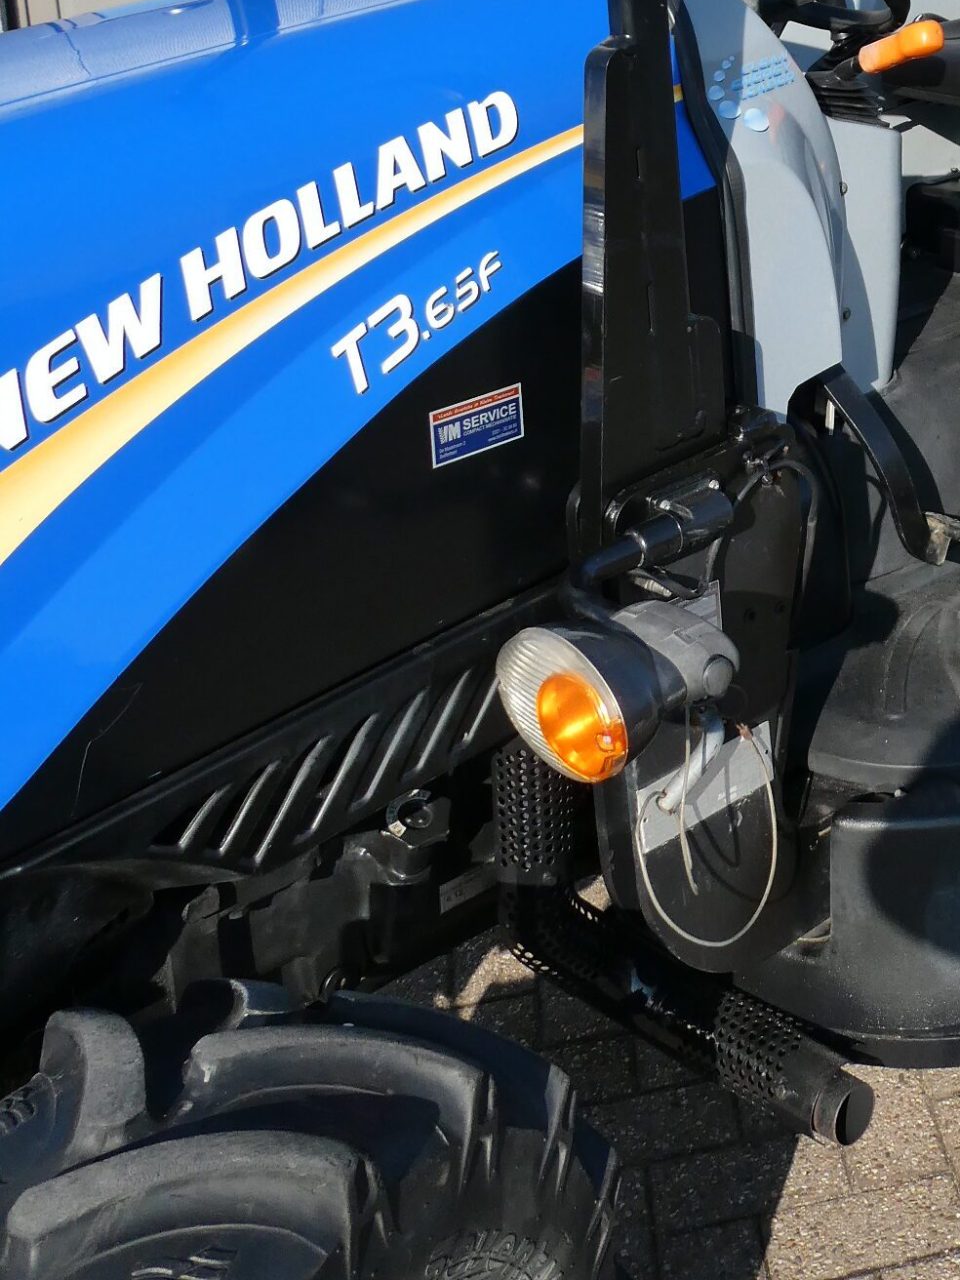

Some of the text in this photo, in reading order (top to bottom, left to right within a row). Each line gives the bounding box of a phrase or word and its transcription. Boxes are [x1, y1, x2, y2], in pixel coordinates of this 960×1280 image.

[180, 91, 518, 321] HOLLAND
[331, 250, 502, 396] T3.65F
[462, 402, 517, 431] SERVICE
